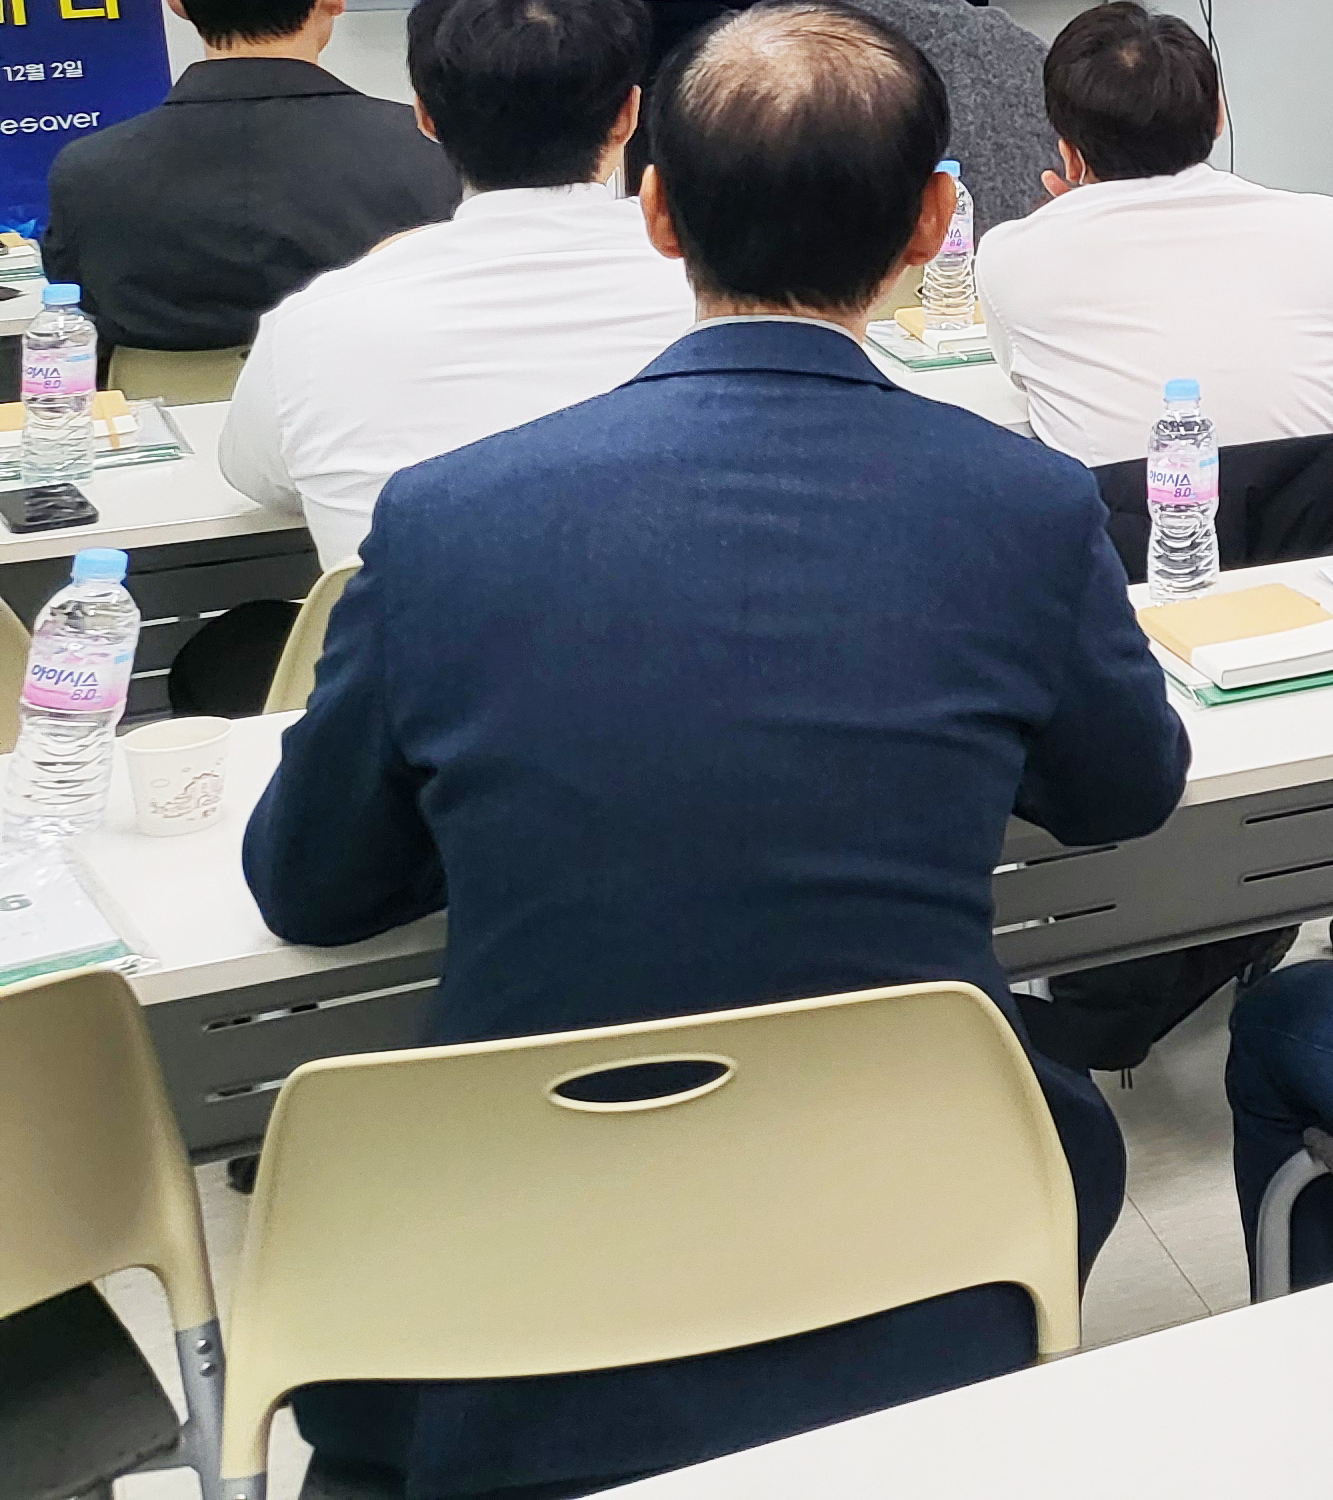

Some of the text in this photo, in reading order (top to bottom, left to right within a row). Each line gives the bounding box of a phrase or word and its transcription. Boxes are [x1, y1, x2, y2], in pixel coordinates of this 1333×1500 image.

[3, 60, 84, 82] 12월 2일
[1173, 487, 1192, 498] 8.0
[32, 664, 99, 688] 아이시스
[70, 688, 97, 701] 8.0
